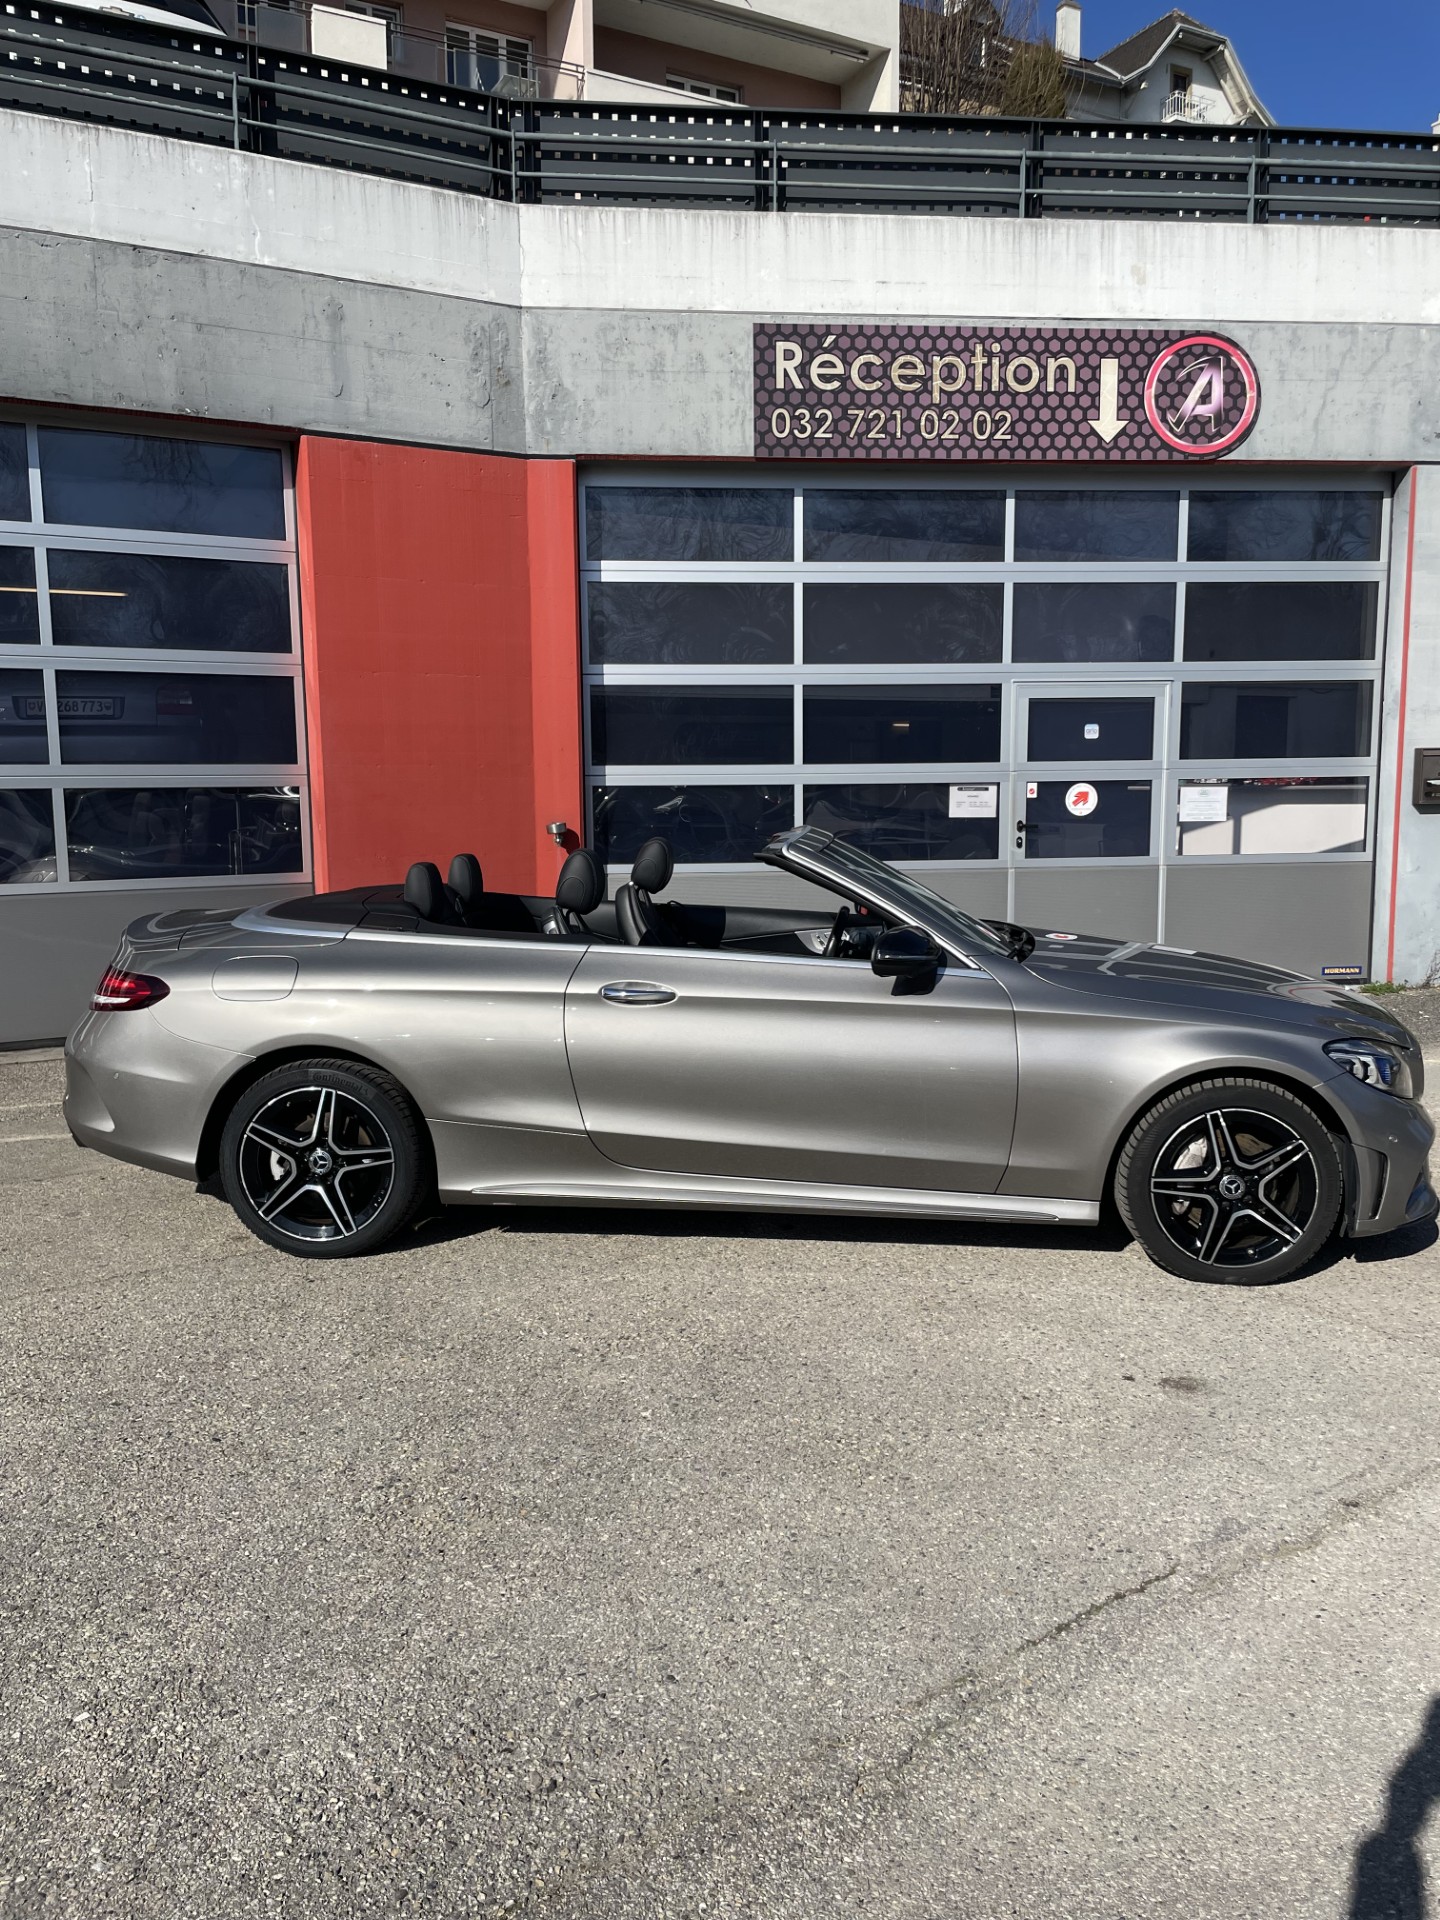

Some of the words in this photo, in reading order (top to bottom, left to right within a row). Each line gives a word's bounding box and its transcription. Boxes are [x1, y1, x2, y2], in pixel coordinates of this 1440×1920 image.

[775, 334, 1076, 404] Réception
[771, 407, 833, 439] 032
[847, 408, 901, 439] 721
[920, 409, 960, 440] 02
[972, 410, 1012, 440] 02
